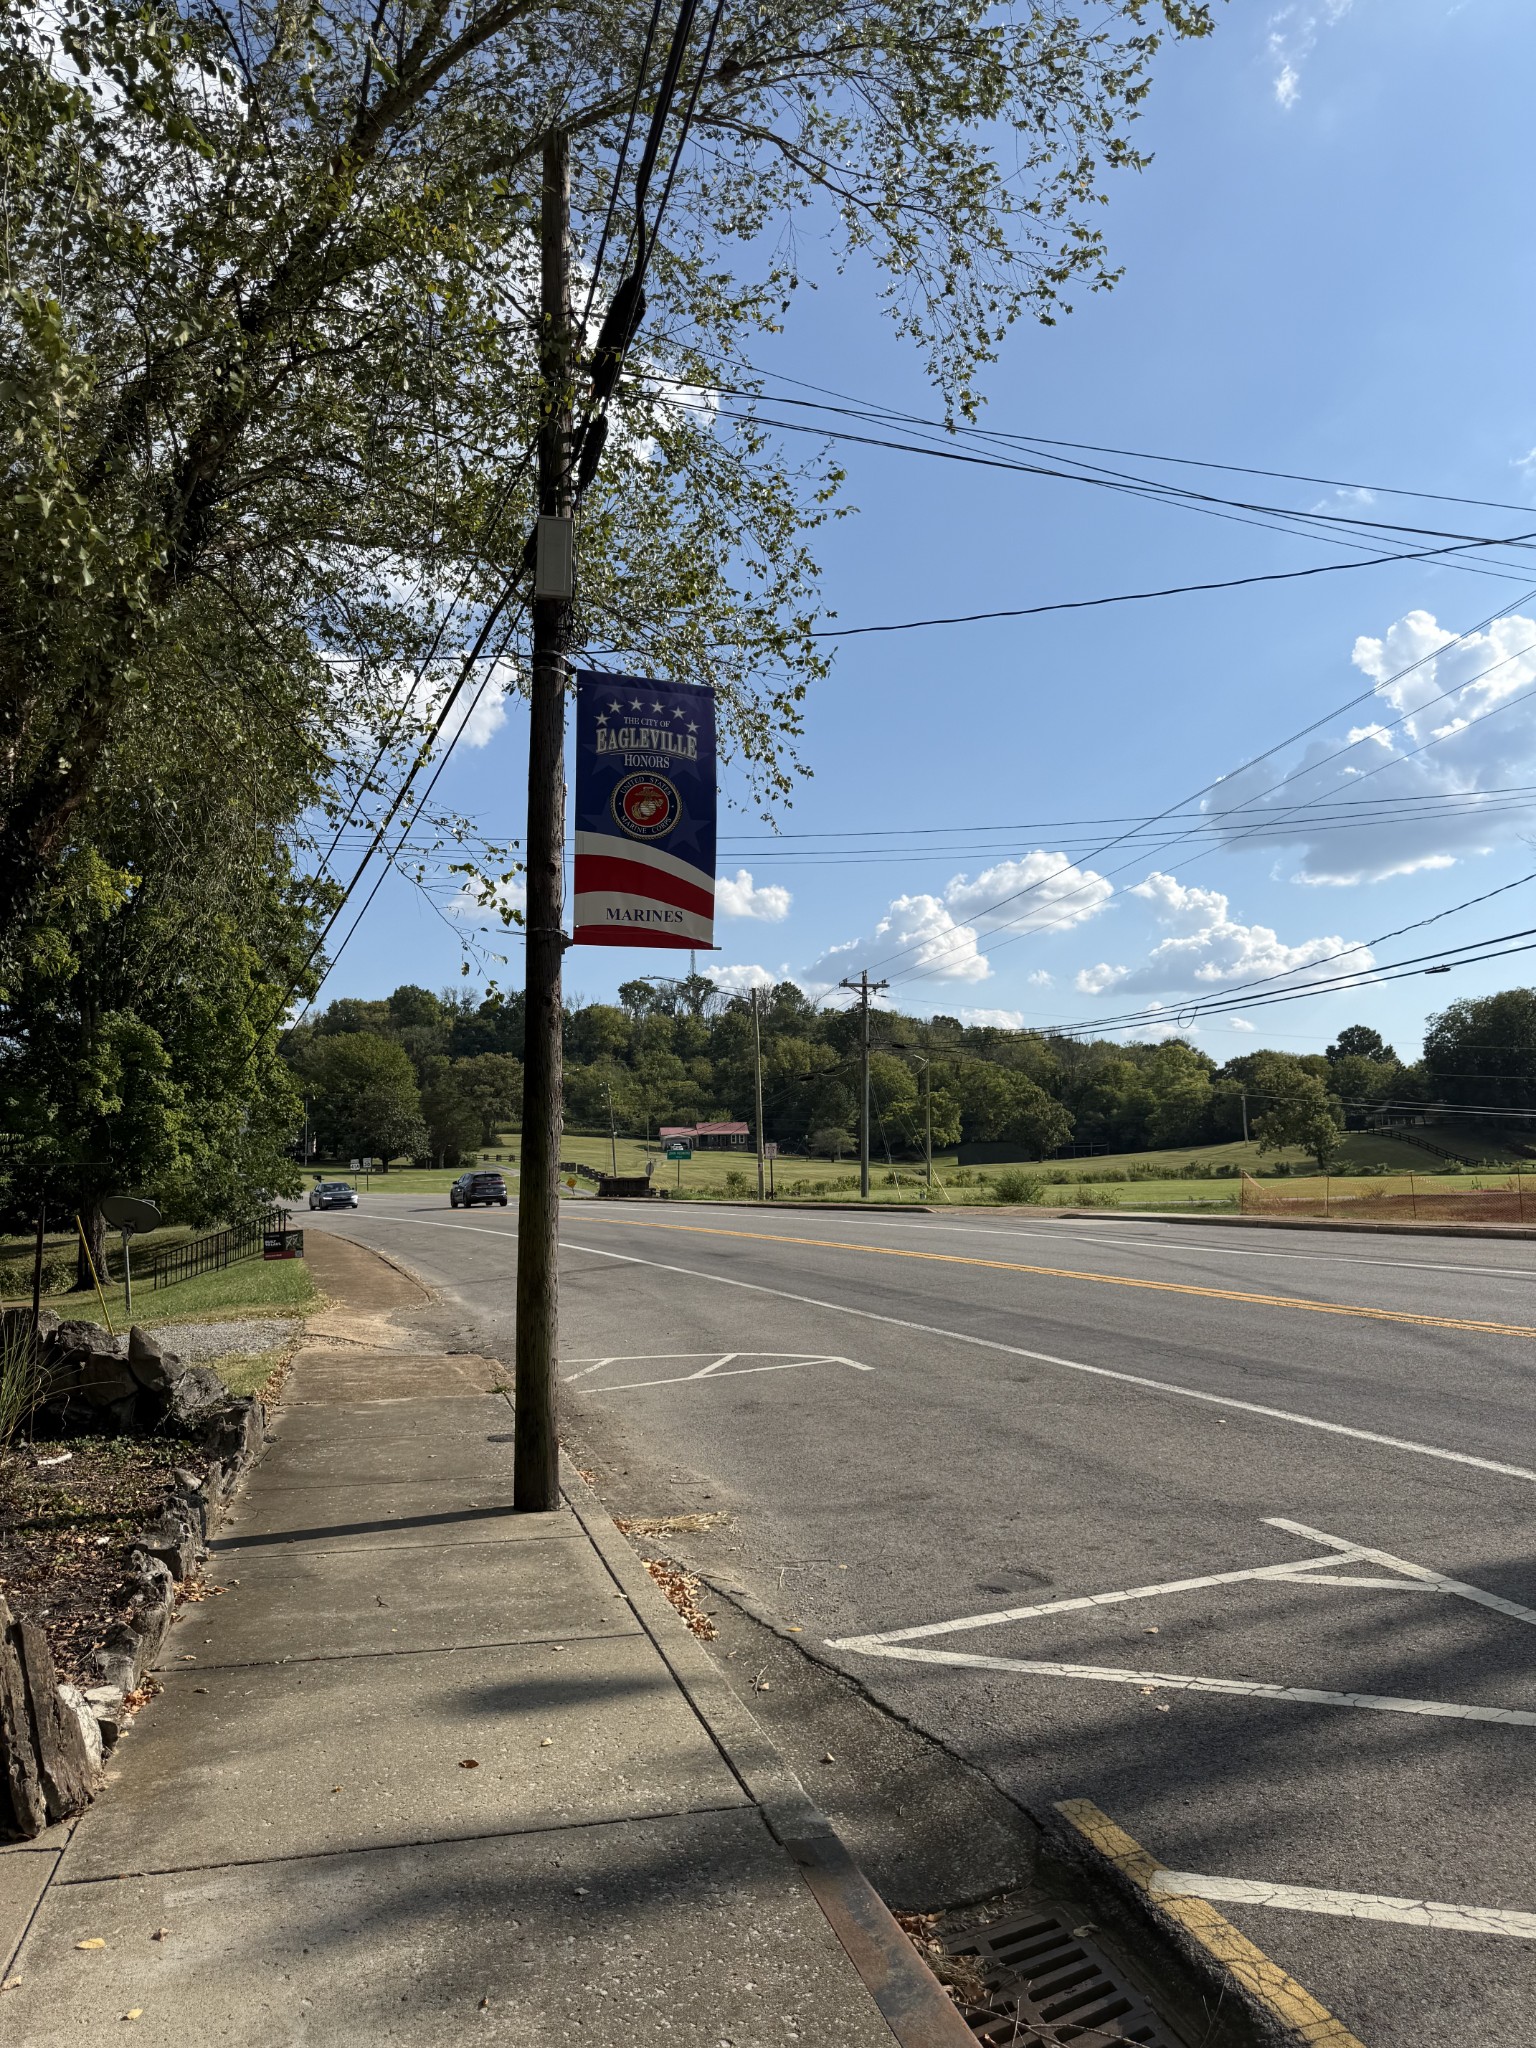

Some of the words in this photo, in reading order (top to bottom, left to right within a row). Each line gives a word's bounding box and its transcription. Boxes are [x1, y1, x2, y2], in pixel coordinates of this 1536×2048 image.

[624, 717, 639, 725] THE
[641, 718, 659, 727] CITY
[596, 728, 698, 760] EAGLEVILLE
[624, 754, 670, 769] HONORS
[620, 777, 645, 794] UNITED
[649, 778, 673, 796] STATES
[621, 815, 647, 834] MARINE
[651, 816, 672, 834] CORPS
[606, 908, 683, 923] MARINES
